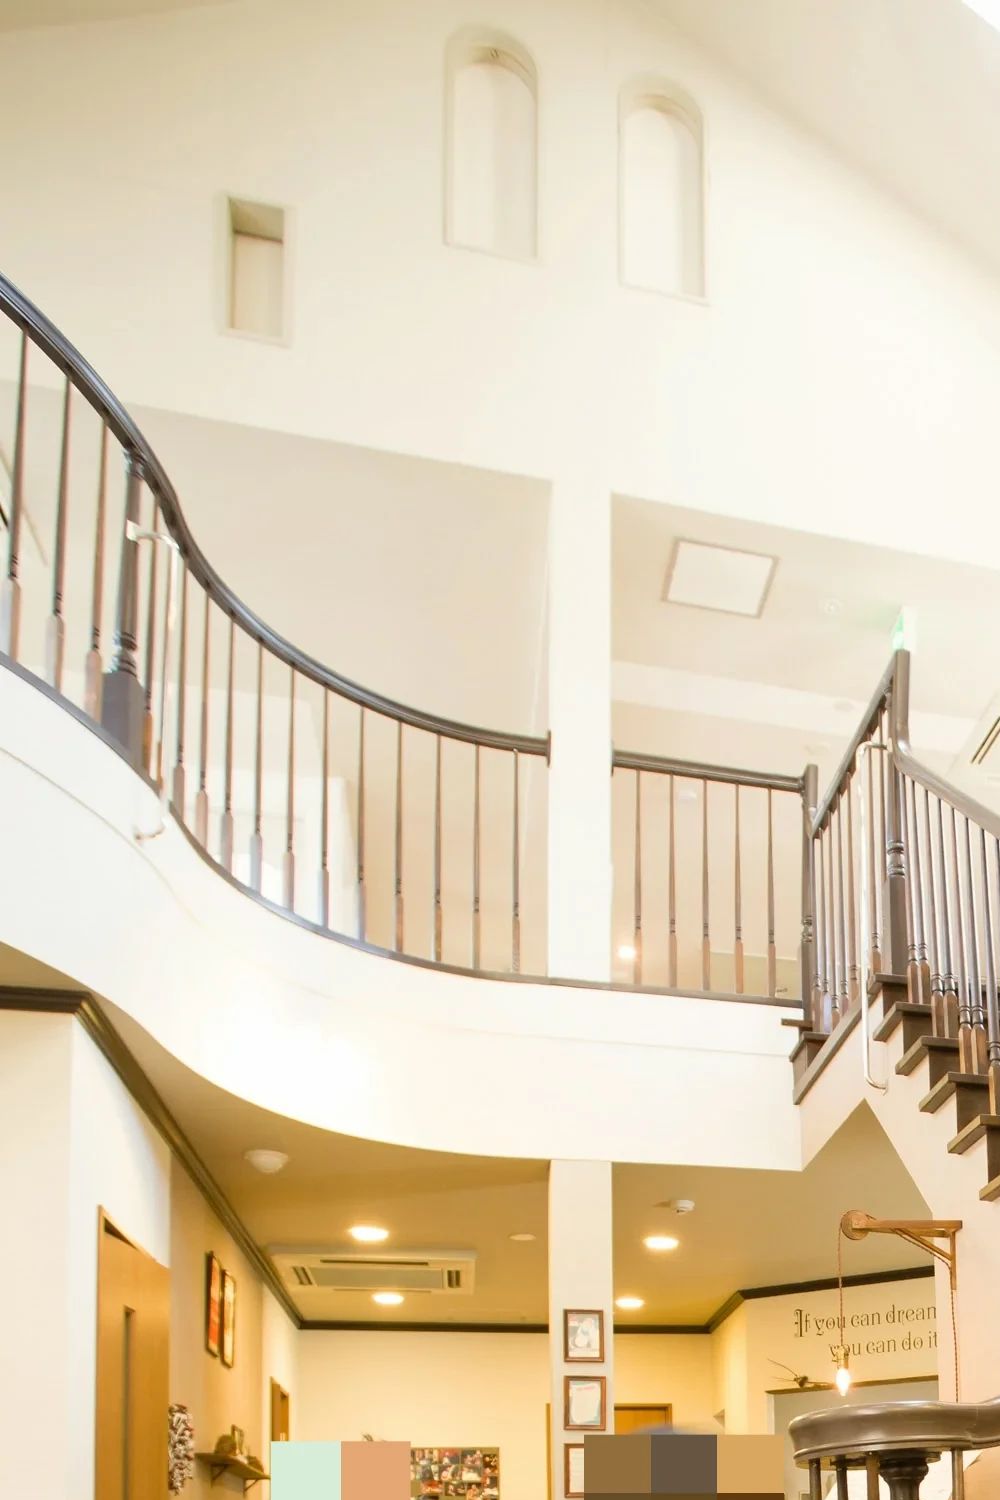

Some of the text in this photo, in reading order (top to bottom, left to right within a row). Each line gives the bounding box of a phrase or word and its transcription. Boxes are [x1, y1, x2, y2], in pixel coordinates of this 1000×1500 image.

[794, 1309, 810, 1337] If
[814, 1317, 846, 1336] you
[850, 1311, 881, 1328] can
[866, 1338, 897, 1355] can
[901, 1332, 924, 1351] do
